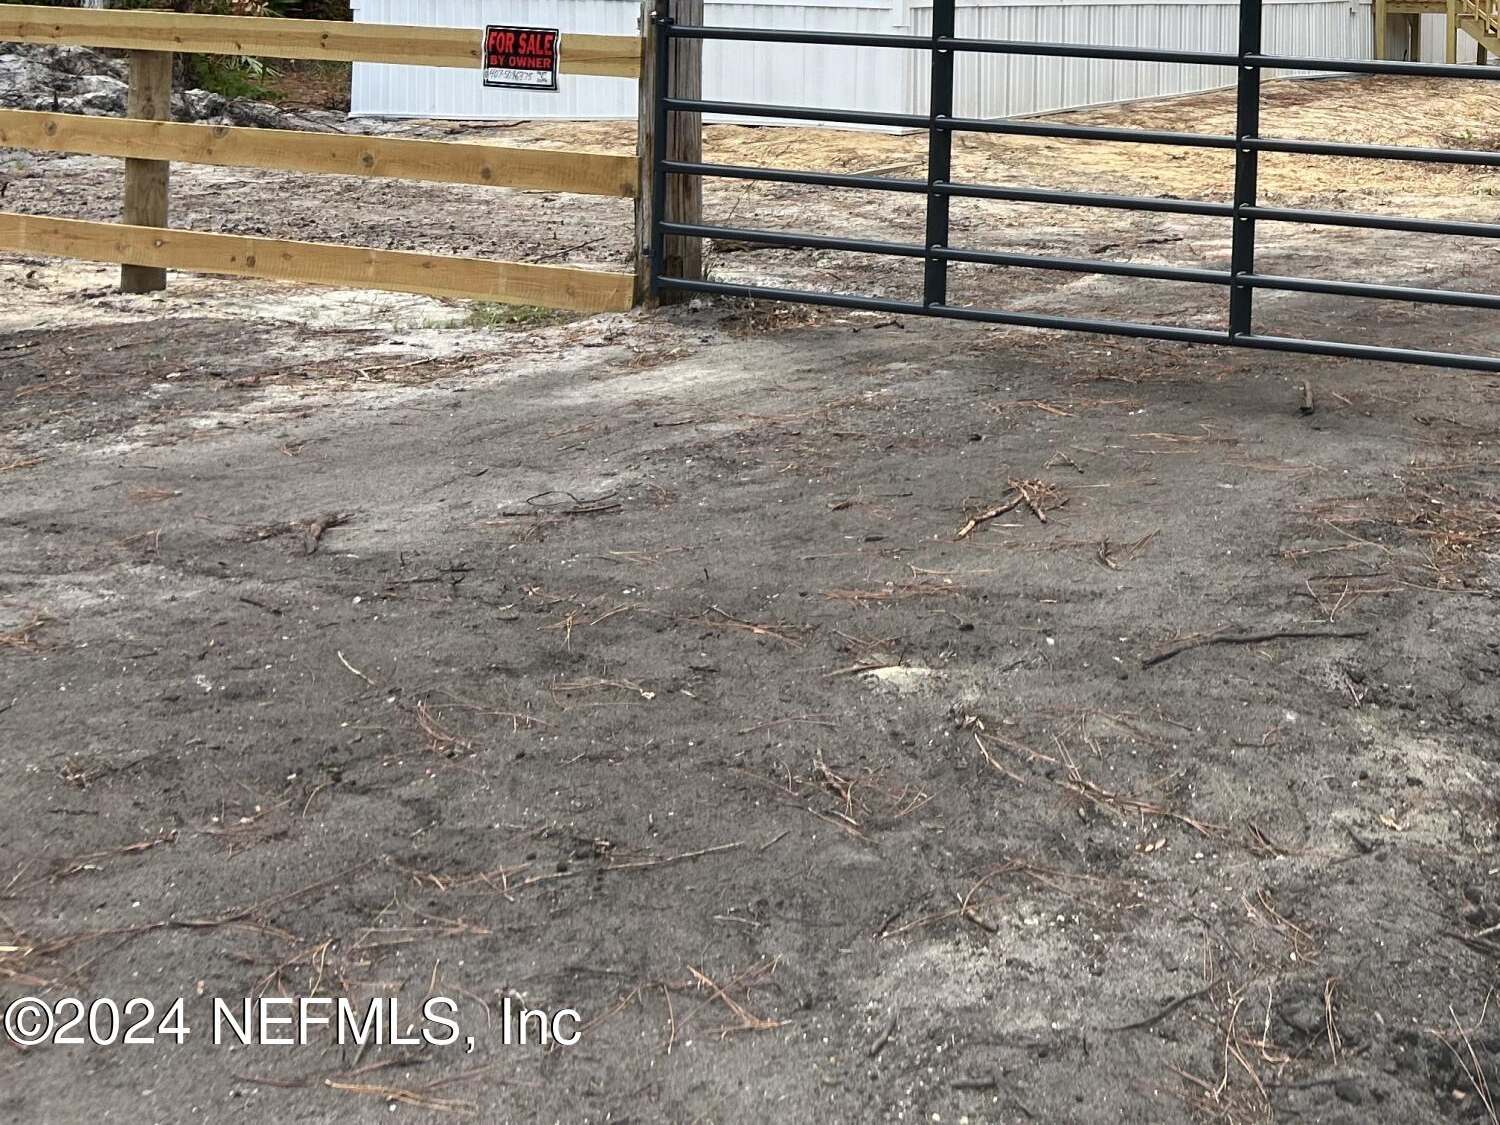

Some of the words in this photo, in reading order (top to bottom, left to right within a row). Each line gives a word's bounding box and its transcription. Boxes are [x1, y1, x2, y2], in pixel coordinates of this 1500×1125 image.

[488, 31, 515, 52] FOR
[518, 33, 554, 56] SALE
[489, 55, 505, 65] BY
[508, 56, 551, 68] OWNER
